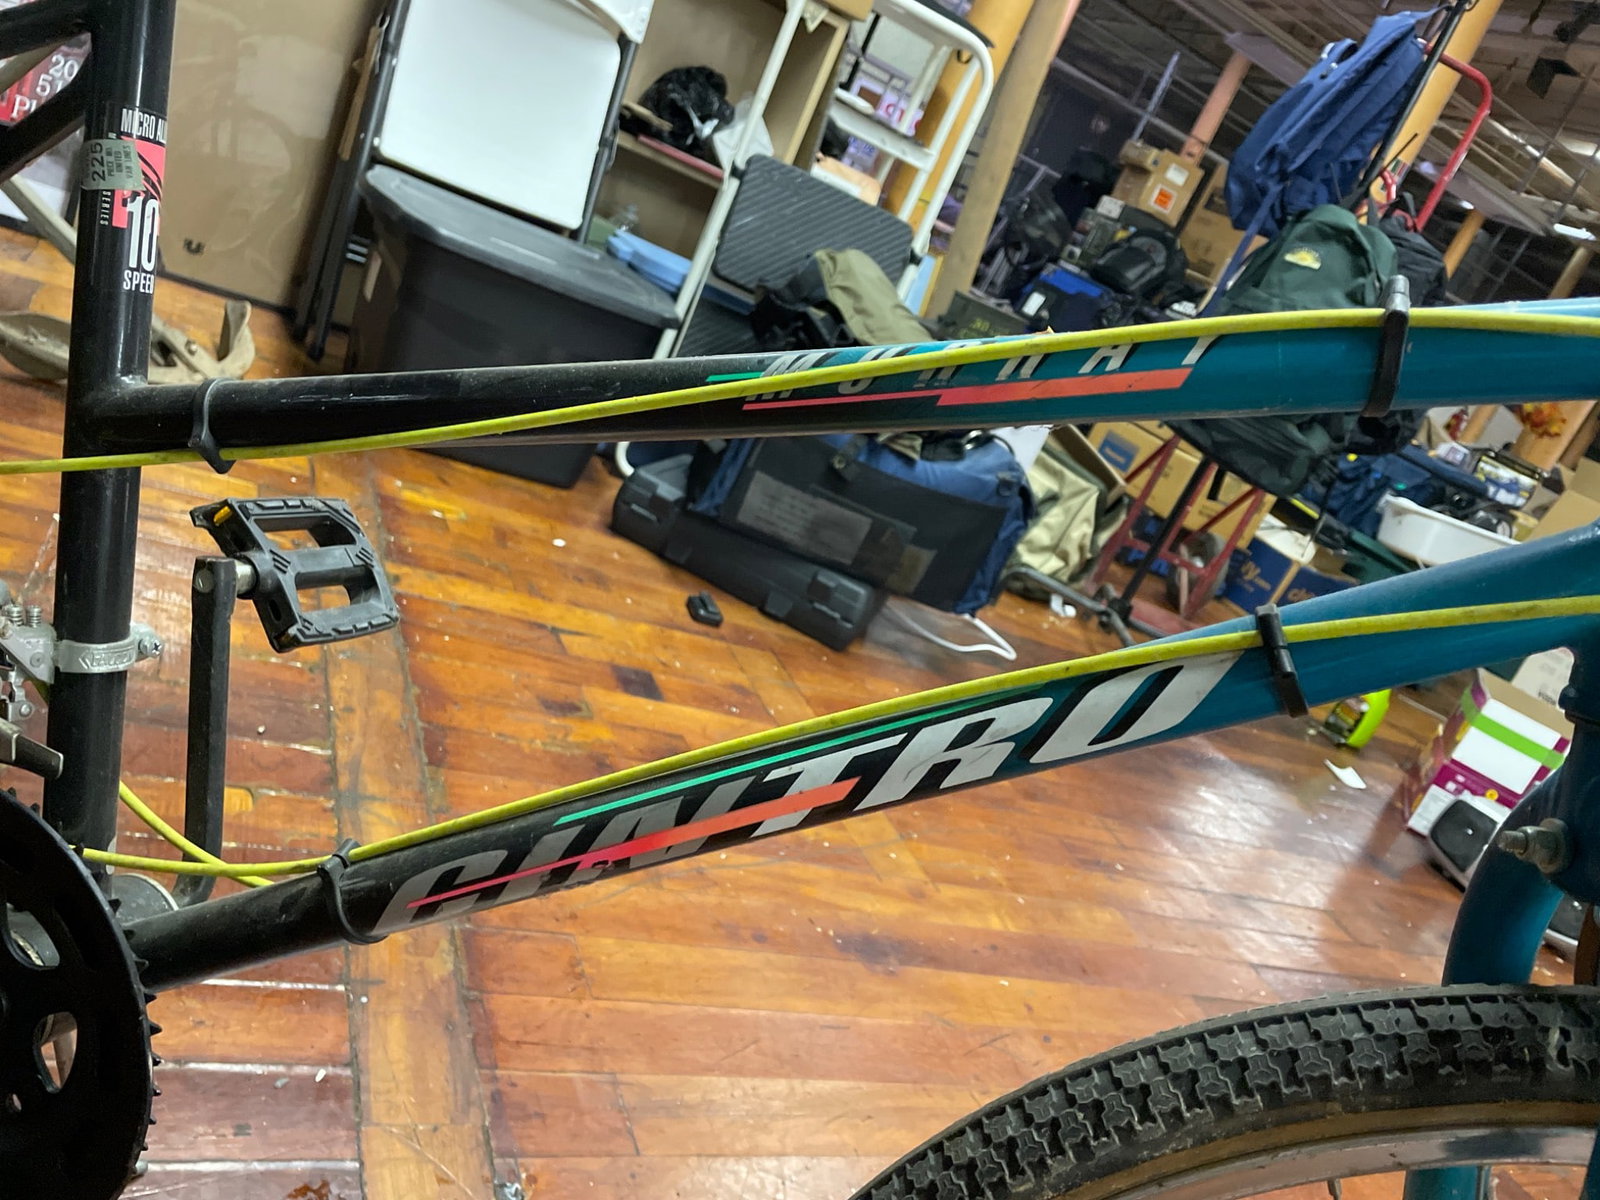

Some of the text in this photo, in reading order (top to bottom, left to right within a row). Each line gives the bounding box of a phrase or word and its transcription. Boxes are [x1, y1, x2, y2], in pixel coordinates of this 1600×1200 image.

[121, 108, 156, 139] MICRO
[91, 142, 105, 182] 225
[100, 191, 112, 225] SERIES
[127, 196, 159, 272] 10
[374, 651, 1242, 935] CINTRO
